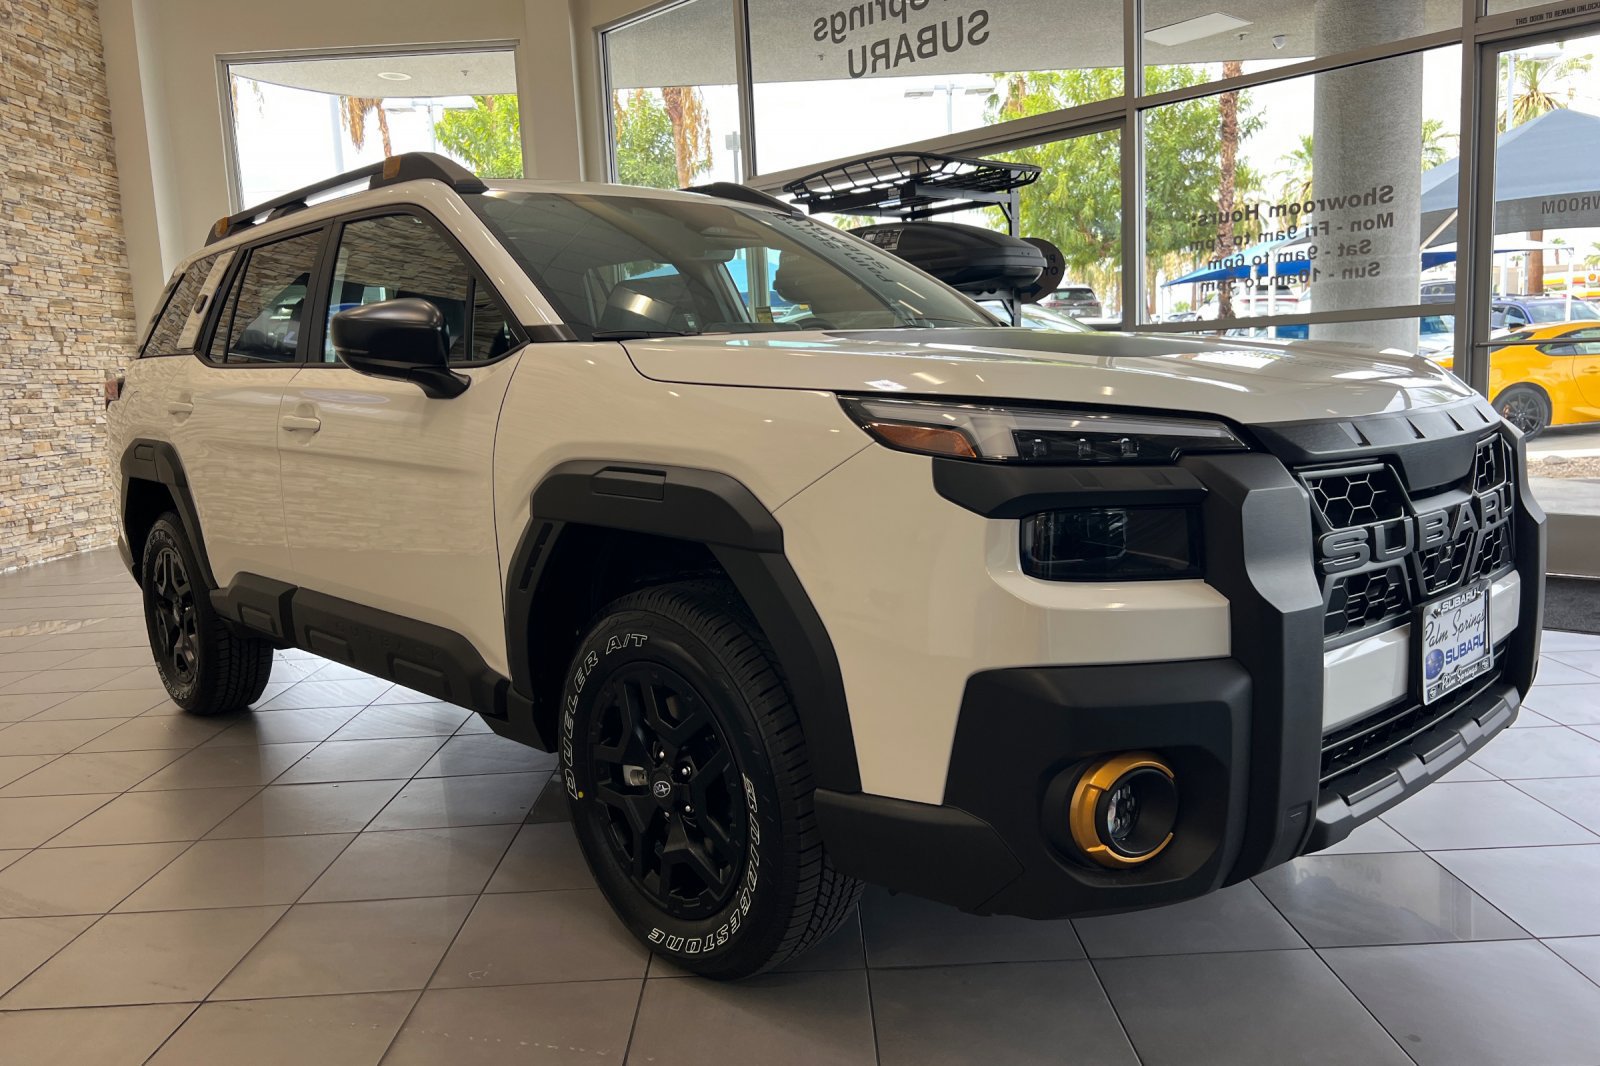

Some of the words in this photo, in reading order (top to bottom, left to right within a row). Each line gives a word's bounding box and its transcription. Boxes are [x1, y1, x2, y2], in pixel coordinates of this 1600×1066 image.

[1515, 17, 1528, 26] THIS
[1554, 6, 1576, 17] REMAIN
[1320, 482, 1514, 574] SUBARU
[1425, 620, 1449, 648] Palm
[1452, 608, 1486, 642] Springs
[1442, 588, 1476, 611] SUBARU
[563, 650, 599, 801] DUELER
[605, 633, 648, 655] A/T
[647, 772, 760, 954] BRIDGESTONE
